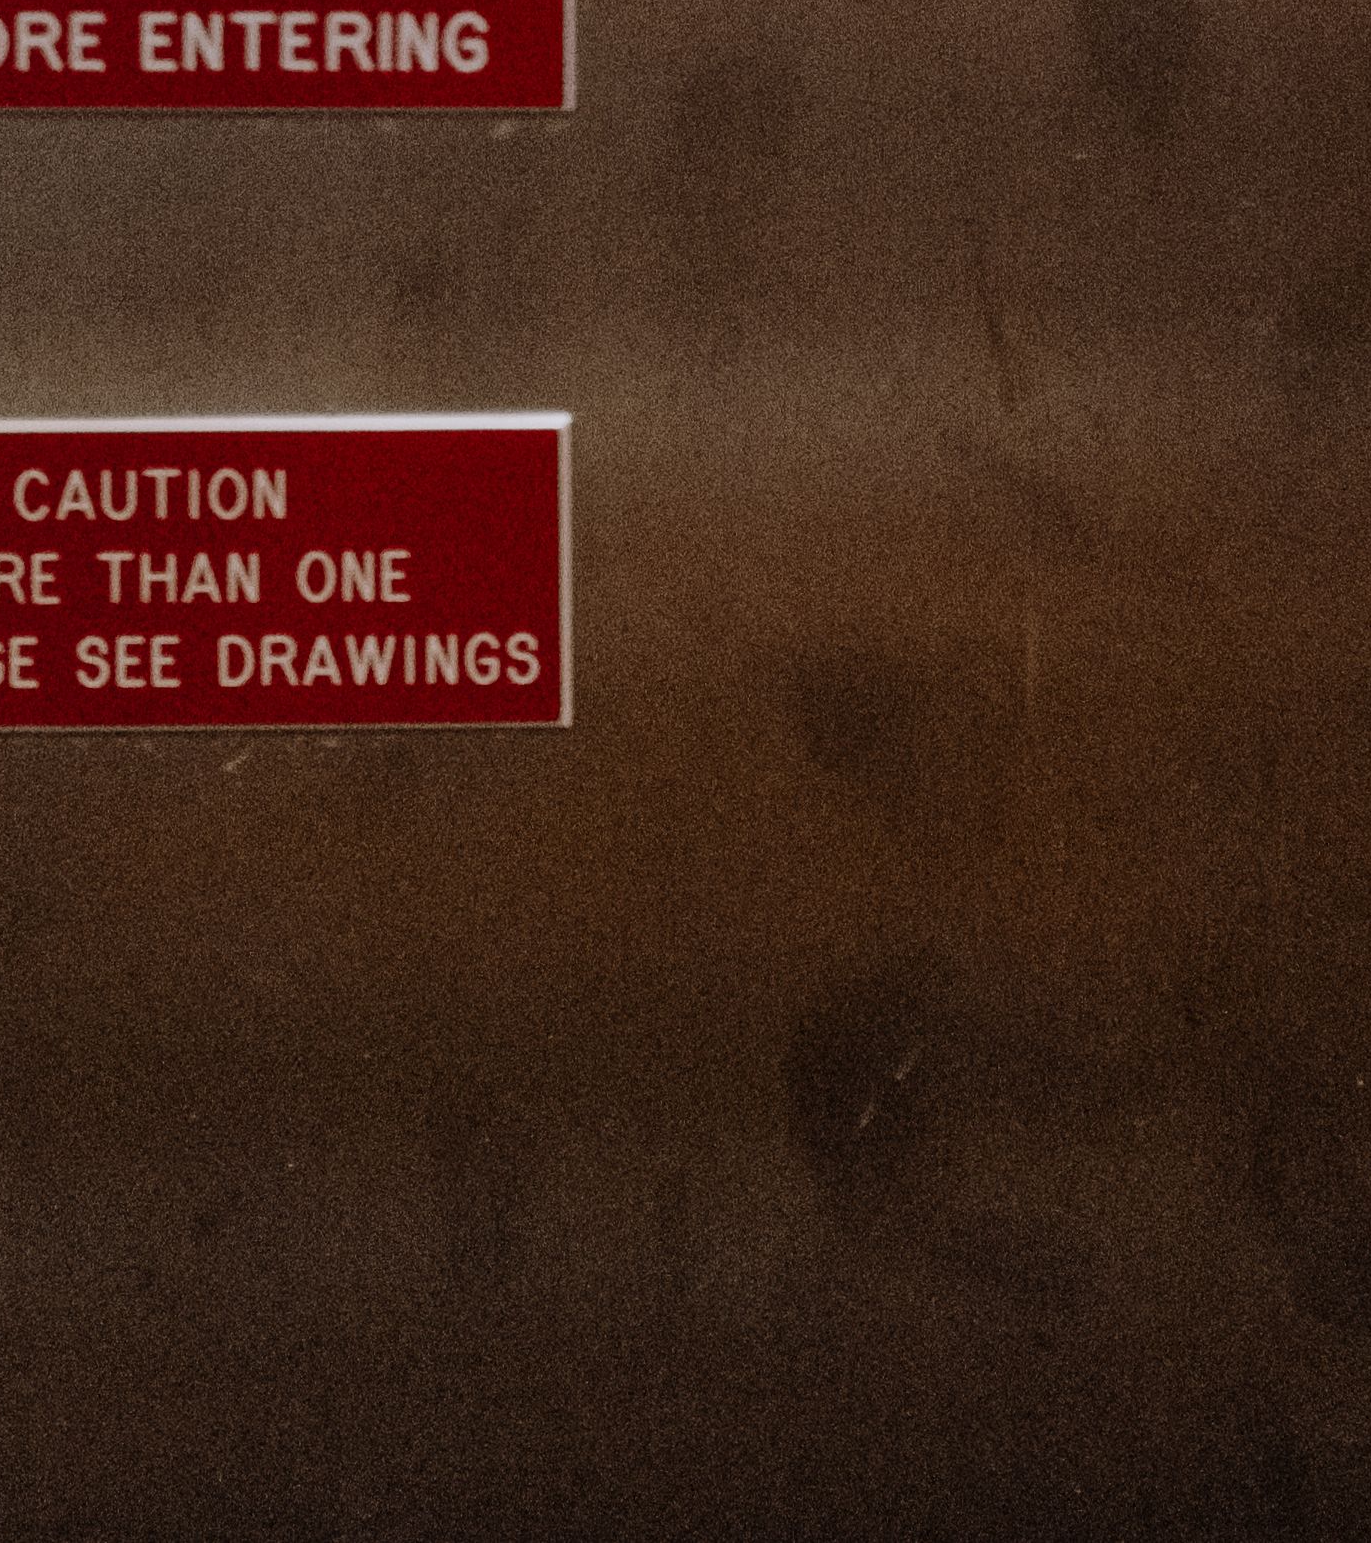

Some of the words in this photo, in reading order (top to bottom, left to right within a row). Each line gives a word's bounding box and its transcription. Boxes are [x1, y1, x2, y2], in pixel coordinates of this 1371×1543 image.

[140, 11, 489, 73] ENTERING
[13, 468, 288, 522] CAUTION
[96, 551, 261, 604] THAN
[295, 549, 411, 603] ONE
[75, 634, 181, 689] SEE
[217, 631, 541, 688] DRAWINGS
